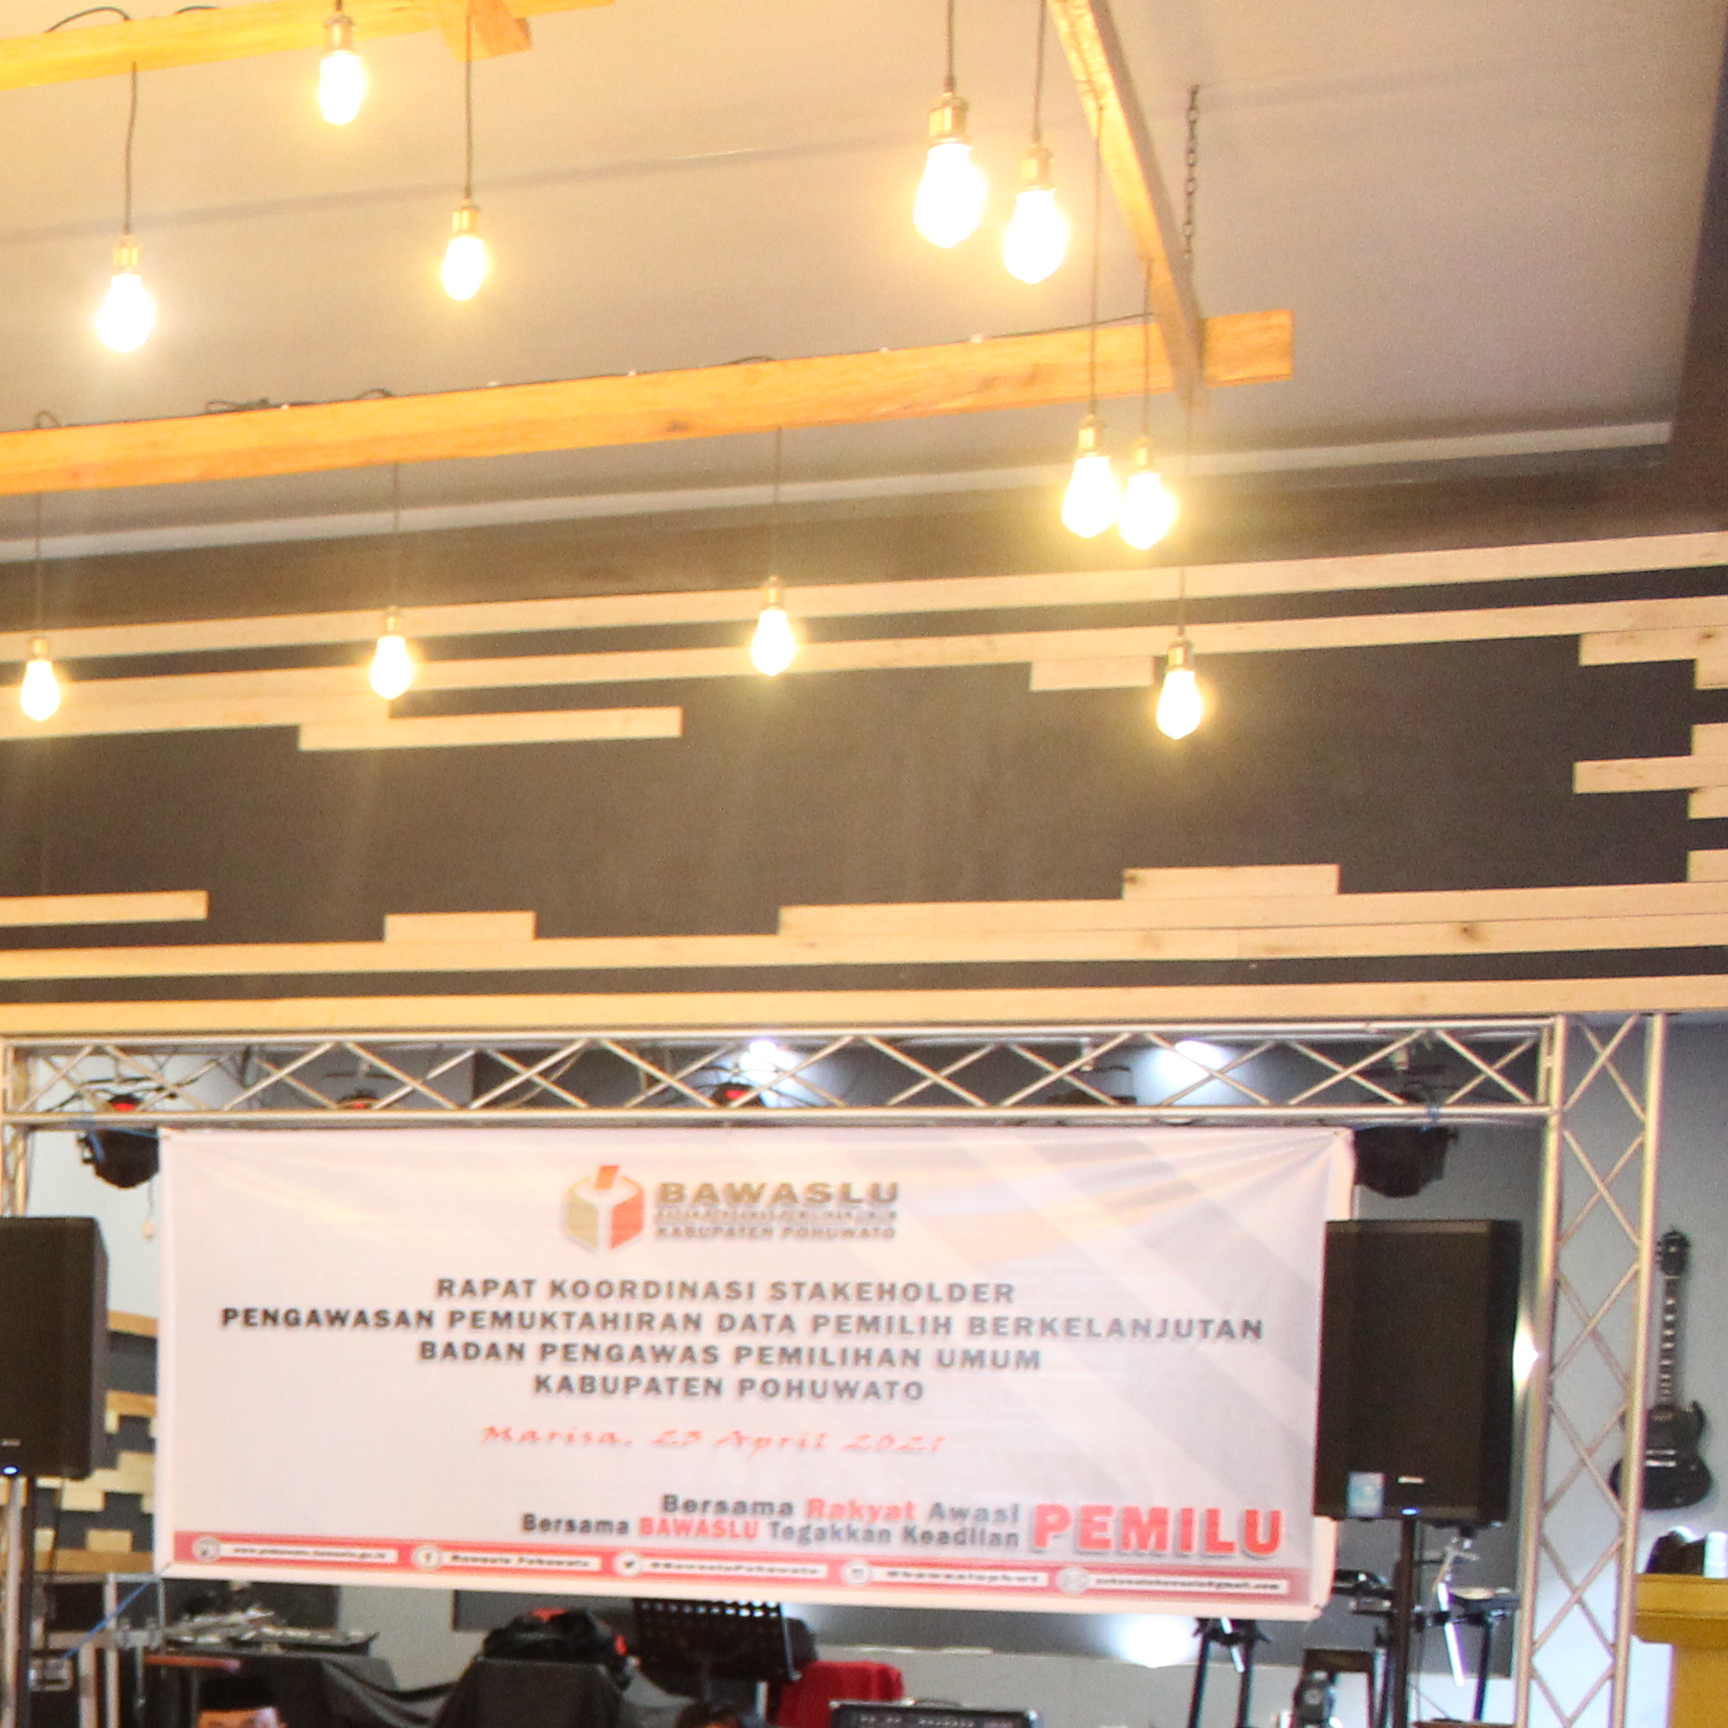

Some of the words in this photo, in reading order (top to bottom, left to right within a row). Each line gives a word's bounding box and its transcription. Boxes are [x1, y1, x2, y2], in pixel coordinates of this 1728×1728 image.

[657, 1181, 900, 1205] BAWASLU
[655, 1226, 774, 1241] KABUPATEN
[780, 1227, 897, 1242] POHUWATO
[437, 1278, 537, 1300] RAPAT
[549, 1279, 756, 1302] KOORDINASI
[769, 1281, 1016, 1304] STAKEHOLDER
[221, 1307, 435, 1330] PENGAWASAN
[448, 1310, 703, 1334] PEMUKTAHIRAN
[717, 1313, 797, 1334] DATA
[811, 1314, 955, 1336] PEMILIH
[968, 1316, 1265, 1341] BERKELANJUTAN
[419, 1340, 527, 1362] BADAN
[540, 1343, 720, 1366] PENGAWAS
[735, 1345, 922, 1368] PEMILIHAN
[936, 1348, 1042, 1371] UMUM
[534, 1374, 723, 1398] KABUPATEN
[738, 1377, 925, 1401] POHUWATO
[714, 1429, 828, 1458] April
[843, 1432, 947, 1453] 2021
[660, 1493, 795, 1517] Bersama
[806, 1497, 916, 1523] Rakyat
[928, 1501, 1021, 1524] Awasi
[521, 1511, 630, 1535] Bersama
[638, 1516, 760, 1540] BAWASLU
[769, 1519, 892, 1546] Tegakkan
[901, 1524, 1021, 1548] Keadilan
[1030, 1502, 1284, 1558] PEMILU
